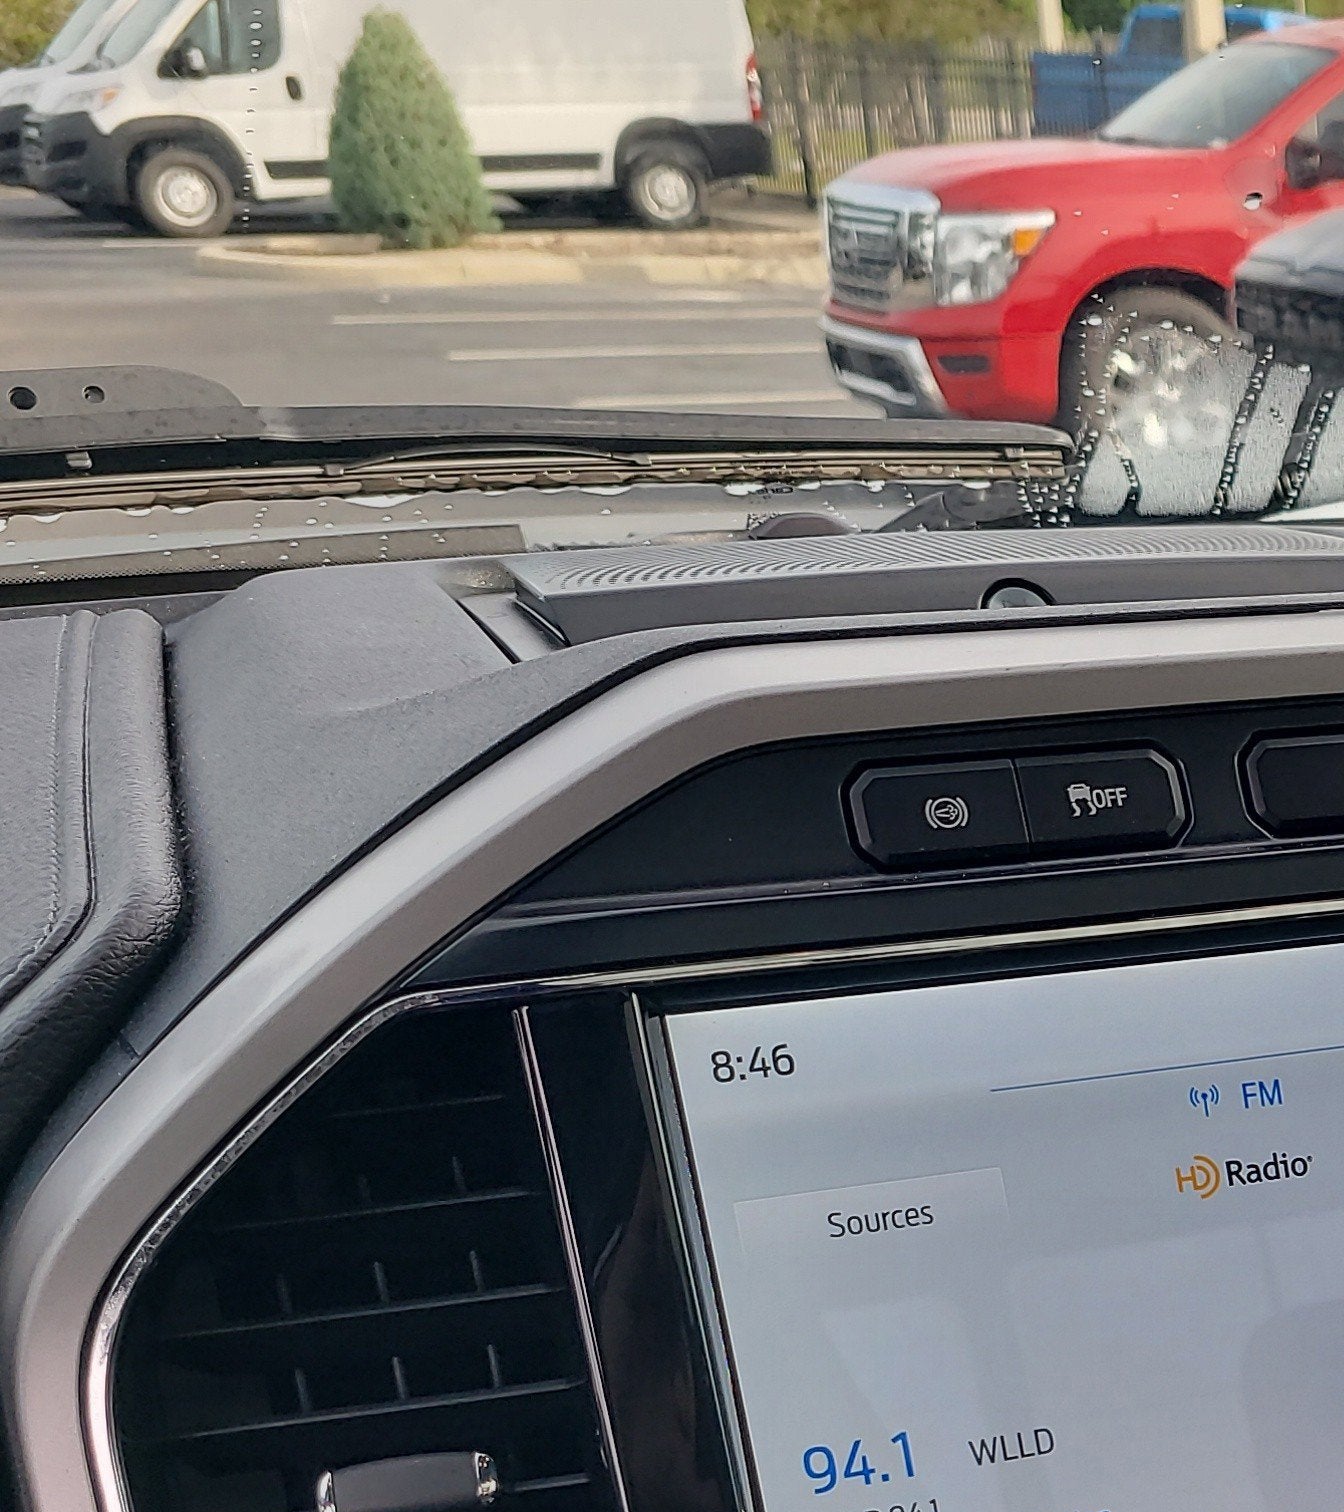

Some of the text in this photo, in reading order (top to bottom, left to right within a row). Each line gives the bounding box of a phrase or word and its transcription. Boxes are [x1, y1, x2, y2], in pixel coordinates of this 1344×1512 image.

[1093, 786, 1127, 809] OFF
[710, 1044, 795, 1084] 8:46
[1242, 1079, 1283, 1109] FM
[827, 1202, 934, 1238] Sources
[803, 1431, 917, 1495] 94.1
[968, 1428, 1055, 1467] WLLD
